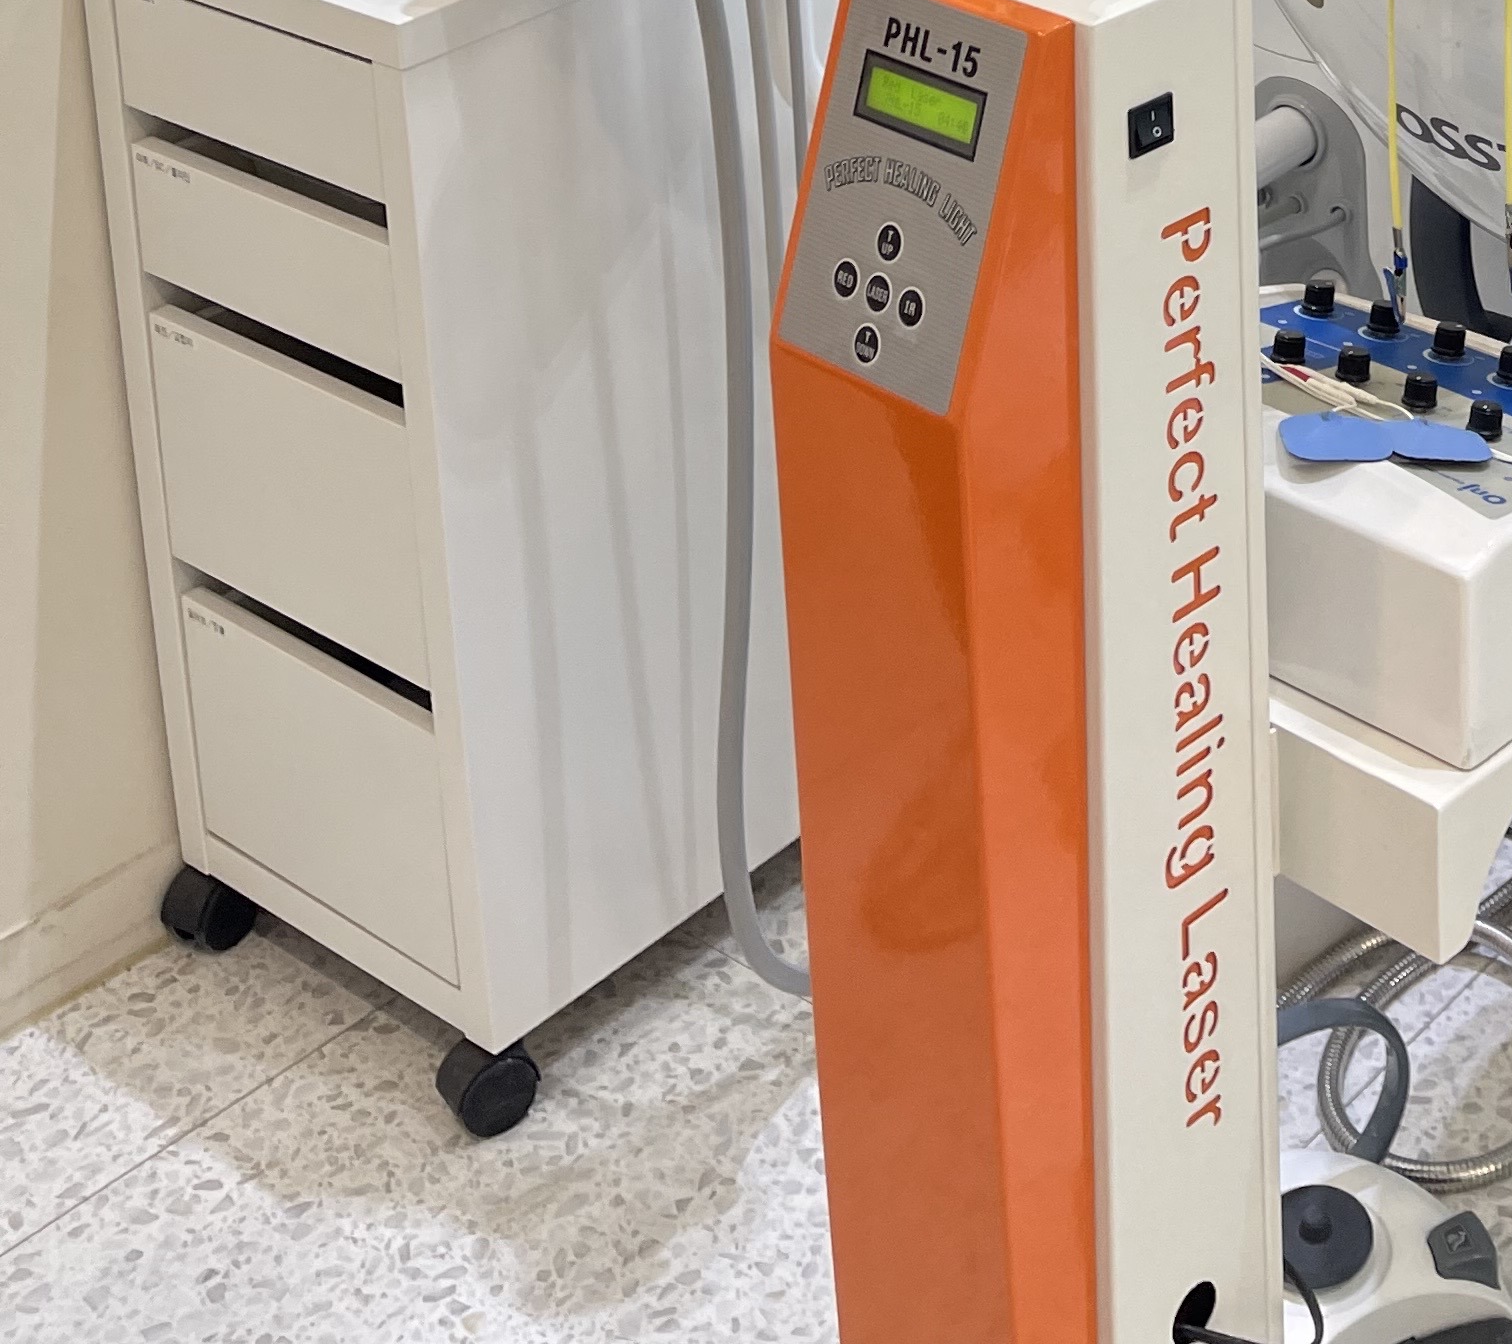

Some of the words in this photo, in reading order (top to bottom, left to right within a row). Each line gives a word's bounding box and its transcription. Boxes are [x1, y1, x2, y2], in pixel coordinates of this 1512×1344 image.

[883, 16, 981, 78] PHL-15
[823, 155, 882, 192] PERFECT
[883, 157, 941, 208] HEALING
[938, 192, 978, 247] LIGHT
[836, 270, 854, 289] RED
[881, 242, 894, 256] UP
[867, 284, 889, 304] LASER
[1161, 206, 1218, 542] Perfect
[1165, 545, 1225, 889] Healing
[1181, 888, 1228, 1128] Laser
